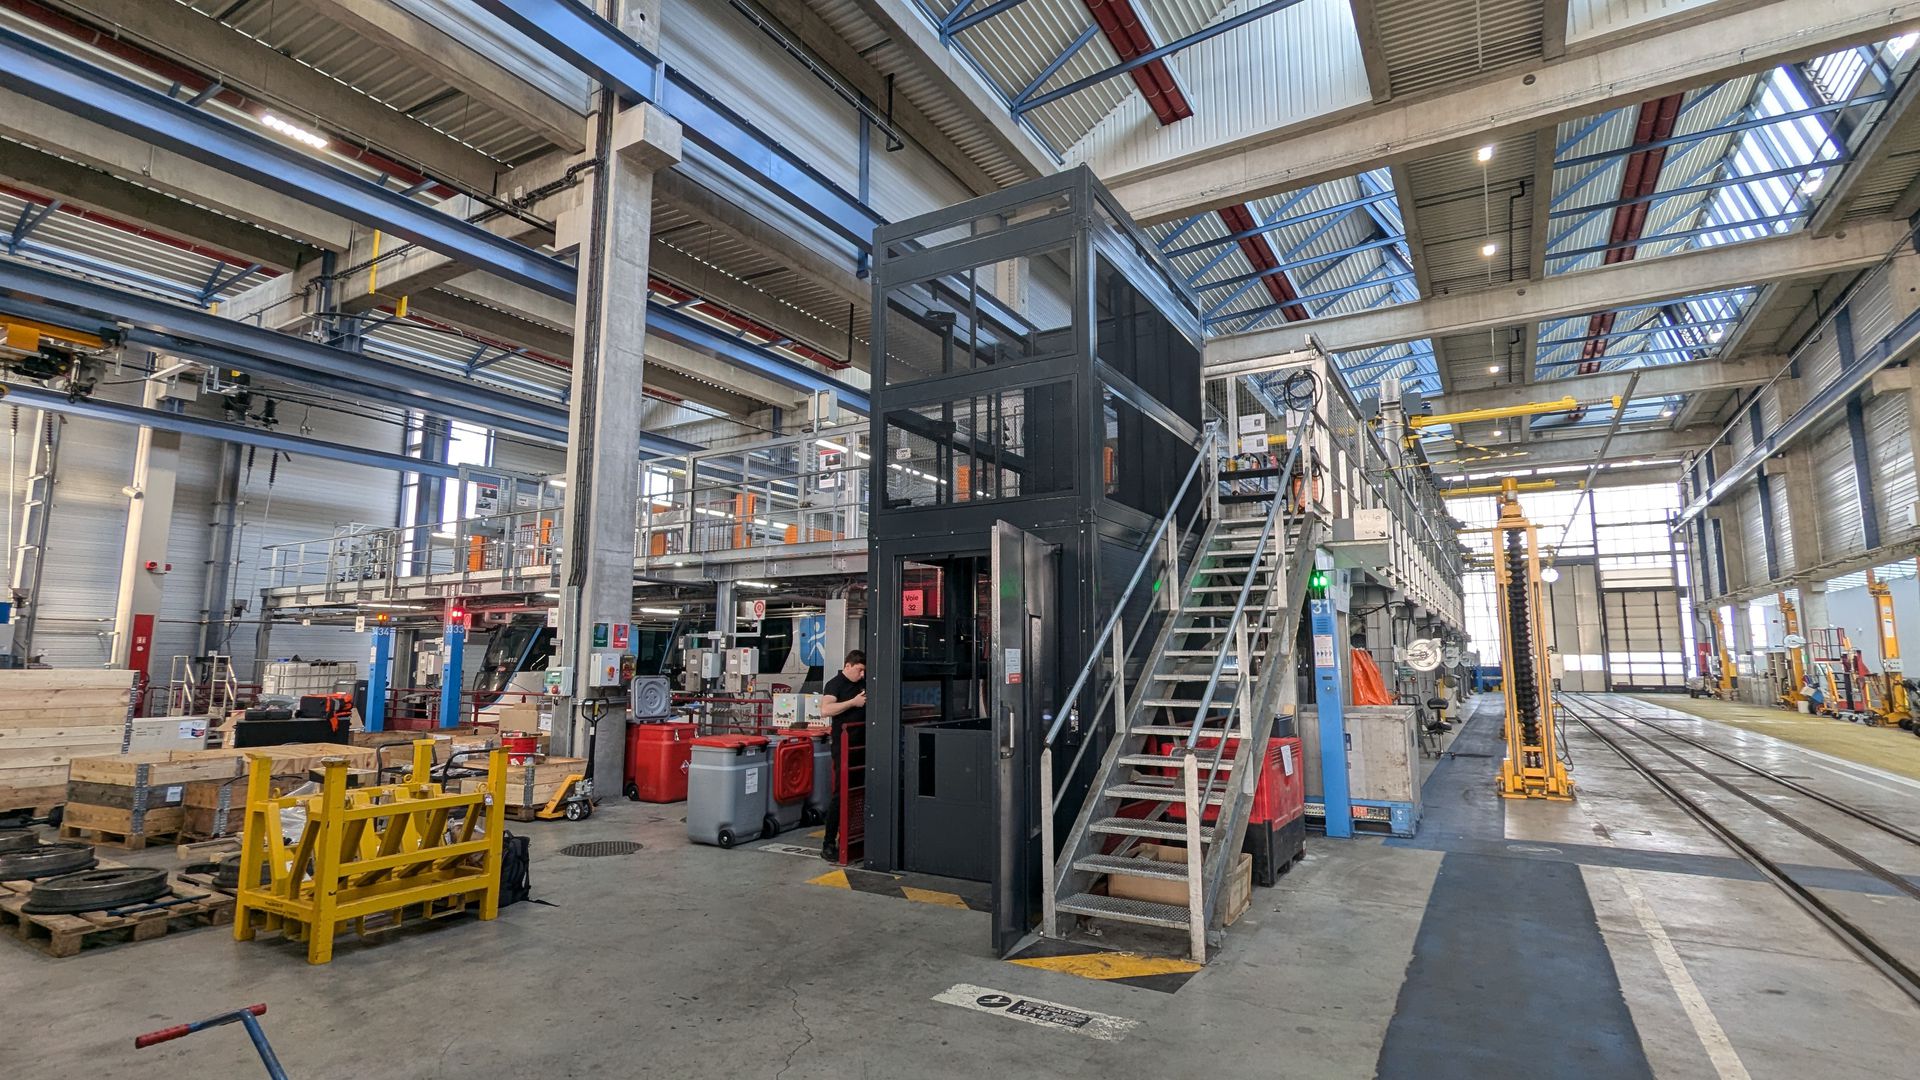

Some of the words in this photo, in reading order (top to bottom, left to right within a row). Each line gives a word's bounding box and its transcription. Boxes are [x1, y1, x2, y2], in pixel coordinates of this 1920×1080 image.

[905, 594, 919, 602] Voie
[1312, 599, 1331, 614] 31
[378, 627, 389, 636] 34
[453, 624, 464, 634] 33
